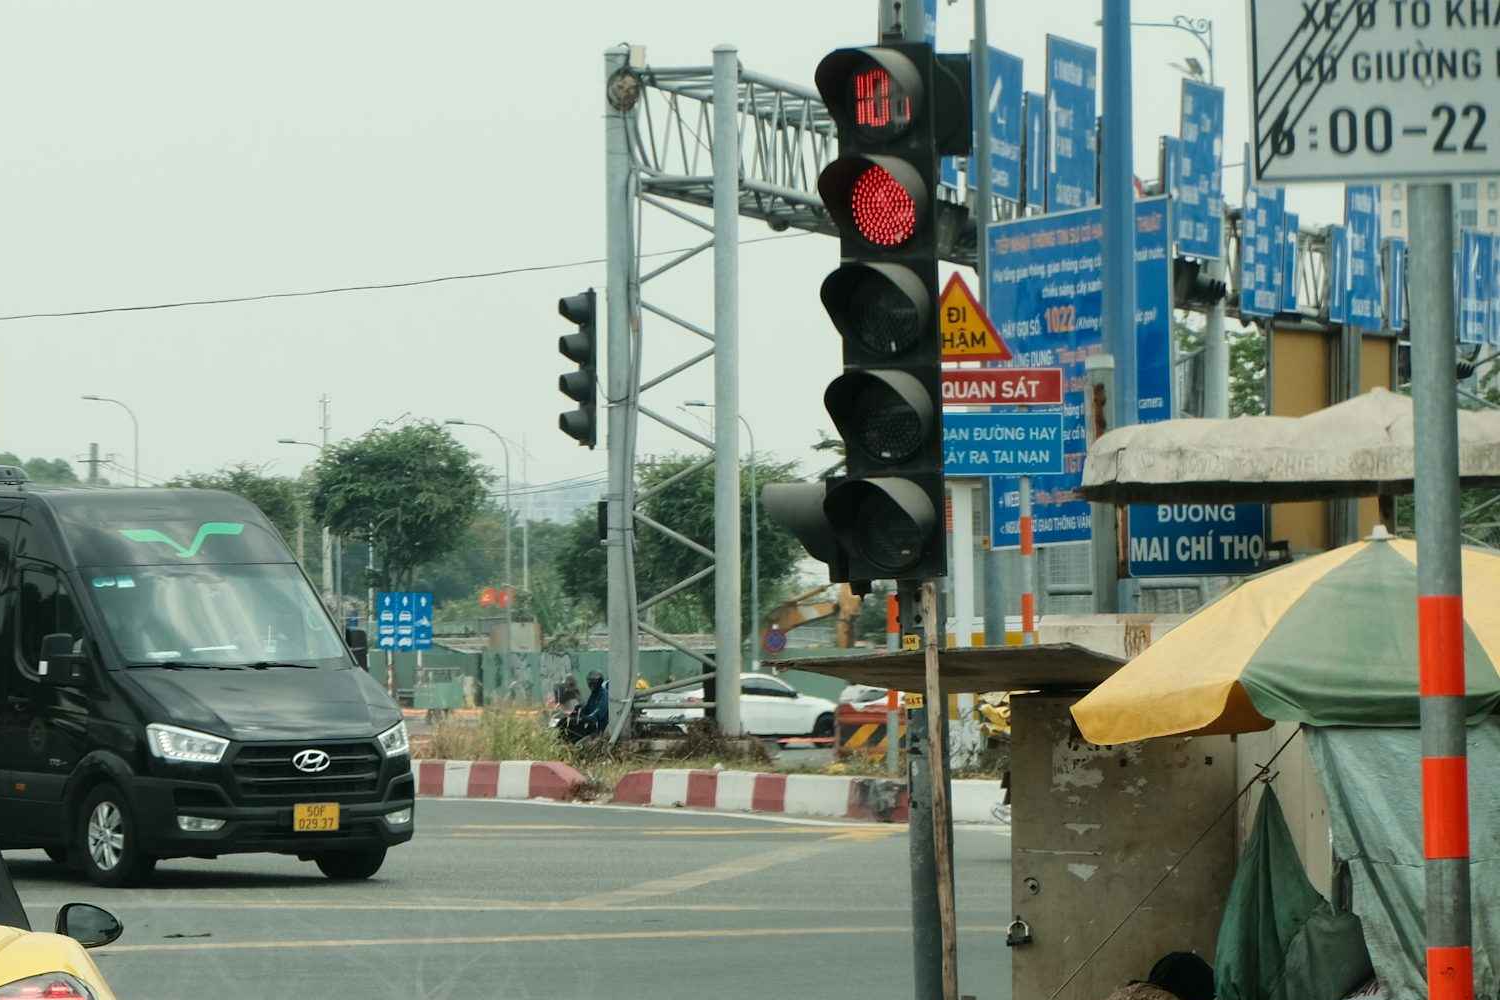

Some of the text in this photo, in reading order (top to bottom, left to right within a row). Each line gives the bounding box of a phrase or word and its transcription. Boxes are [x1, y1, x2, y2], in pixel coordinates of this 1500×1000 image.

[946, 306, 967, 324] ĐI
[1044, 304, 1076, 335] 1022
[940, 328, 987, 354] HẬM
[942, 380, 997, 400] QUAN
[1002, 376, 1040, 399] SÁT
[1029, 425, 1058, 441] HAY
[969, 449, 990, 465] RA
[1018, 448, 1050, 468] NẠN
[1130, 529, 1264, 567] MAI CHÍ THỌ
